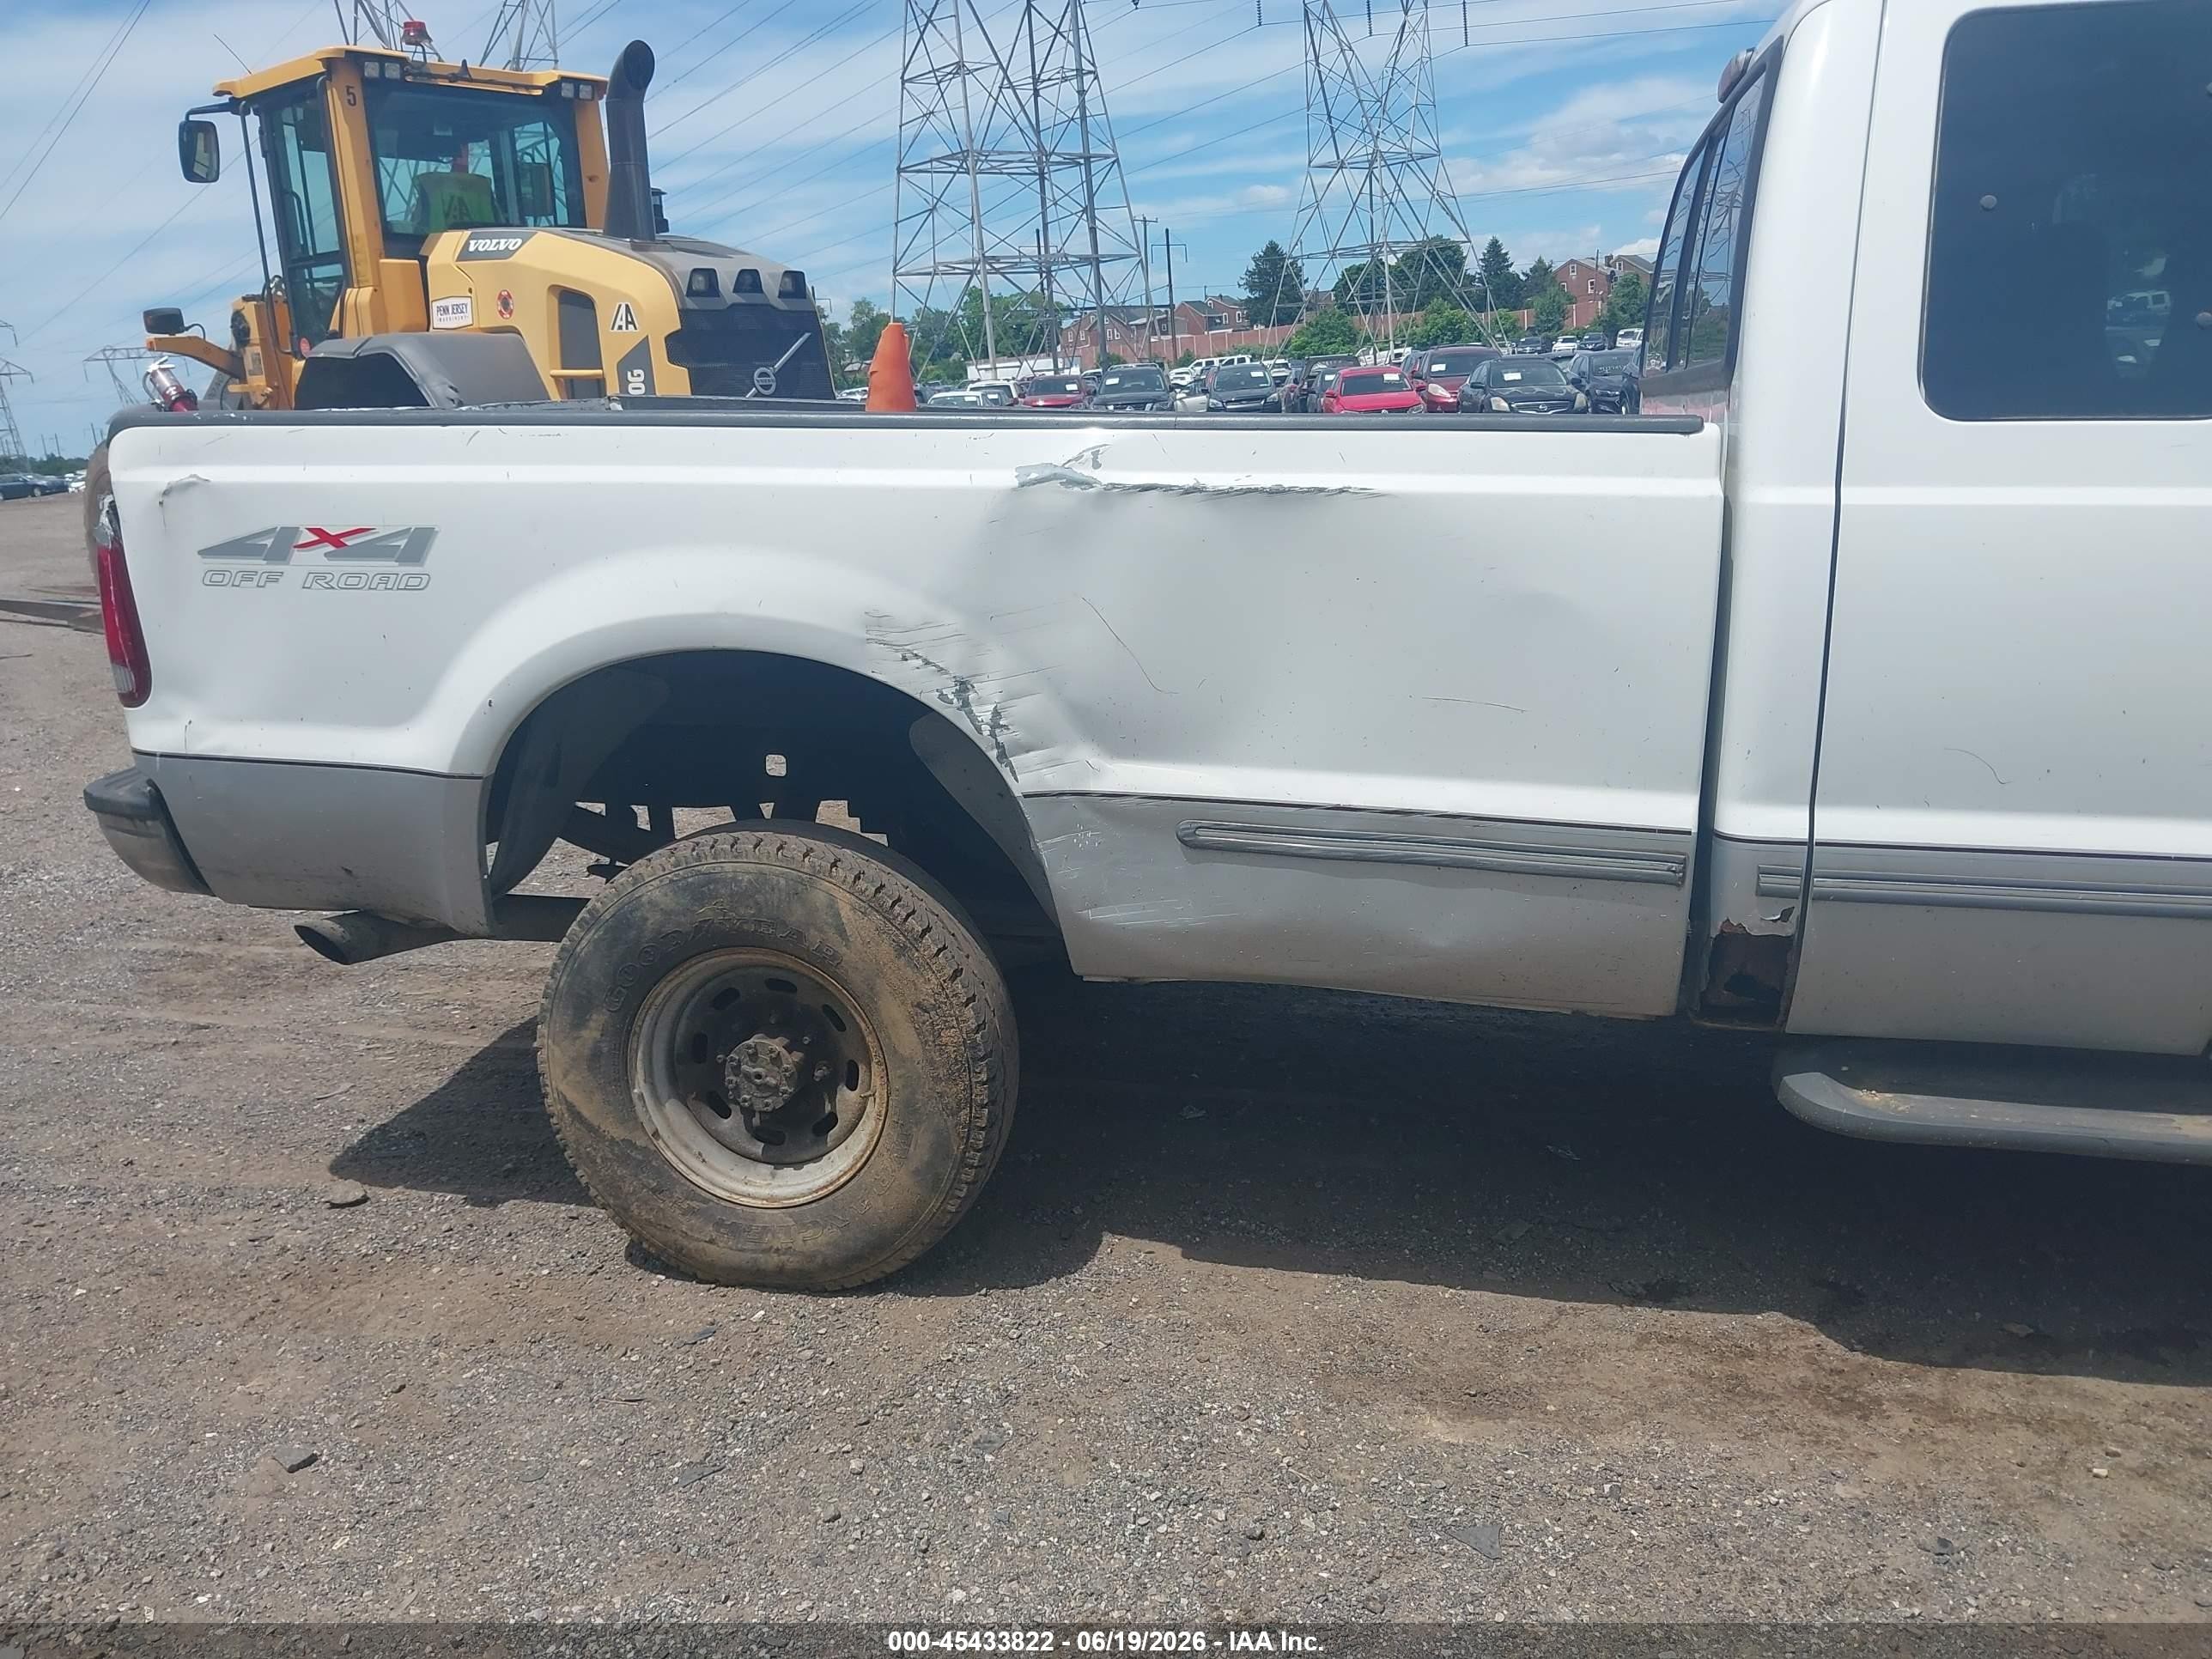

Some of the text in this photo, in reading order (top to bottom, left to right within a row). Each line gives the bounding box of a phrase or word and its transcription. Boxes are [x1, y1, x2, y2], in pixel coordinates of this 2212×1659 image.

[345, 84, 357, 107] 5
[468, 238, 523, 252] VOLVO
[436, 302, 469, 317] PENN JERSEY
[202, 569, 432, 592] OFF ROAD
